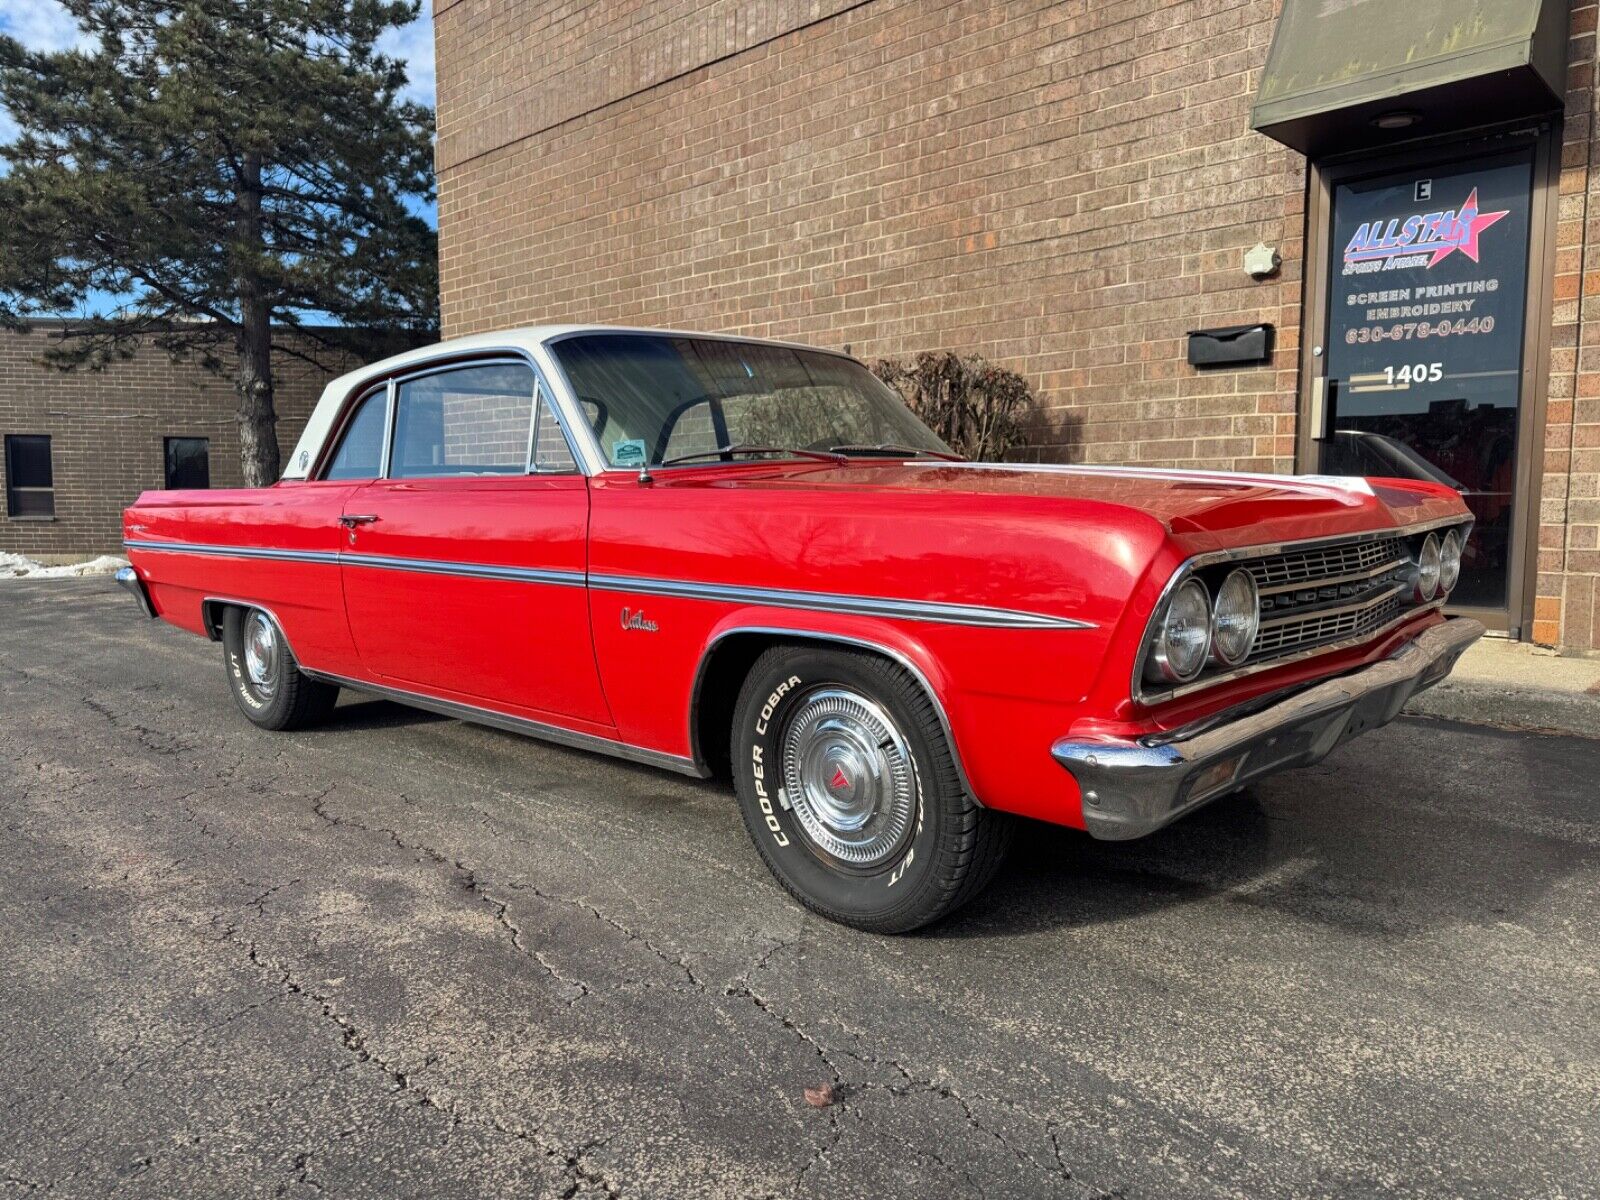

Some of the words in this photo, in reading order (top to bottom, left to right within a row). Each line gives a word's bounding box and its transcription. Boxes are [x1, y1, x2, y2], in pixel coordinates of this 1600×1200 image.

[1416, 180, 1430, 200] E
[1344, 208, 1478, 253] ALLSTAR
[1347, 288, 1410, 305] SCREEN
[1415, 279, 1499, 299] PRINTING
[1366, 299, 1475, 321] EMBROIDERY
[1345, 316, 1494, 344] 630-678-0440
[1383, 362, 1443, 384] 1405
[756, 675, 801, 736] COBRA
[753, 745, 790, 847] COOPER
